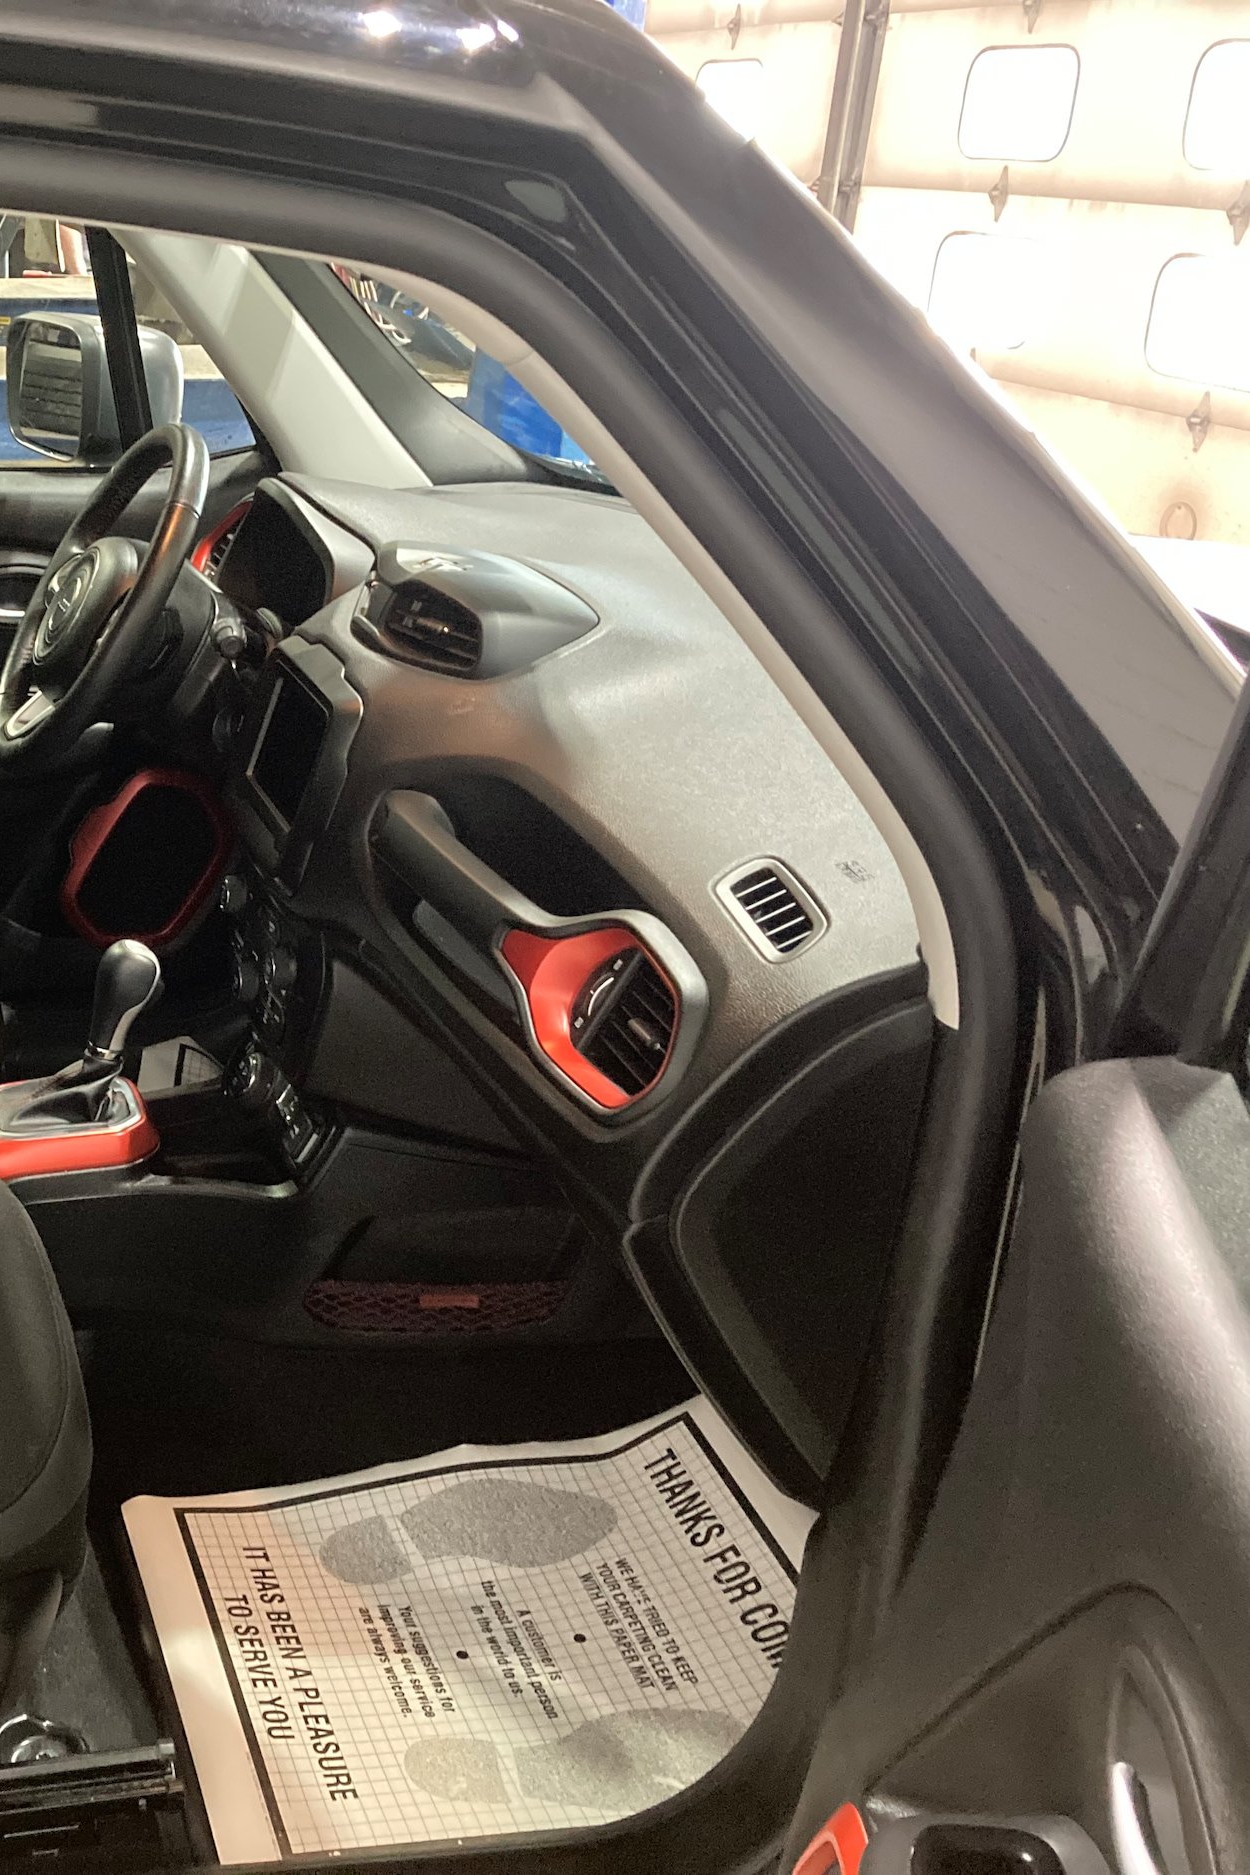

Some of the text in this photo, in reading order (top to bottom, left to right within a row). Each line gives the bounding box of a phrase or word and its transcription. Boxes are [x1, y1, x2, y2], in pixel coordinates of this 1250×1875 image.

[644, 1448, 726, 1547] THANKS
[703, 1544, 762, 1604] FOR
[358, 1607, 412, 1718] are always welcome.
[399, 1606, 455, 1712] Your suggestions for
[470, 1605, 485, 1615] in
[477, 1616, 493, 1634] the
[481, 1580, 558, 1720] the most important person
[486, 1635, 512, 1666] world
[516, 1609, 562, 1682] A customer is
[580, 1572, 655, 1689] WITH THIS PAPER MAT
[596, 1562, 678, 1691] YOUR CARPETING CLEAN
[615, 1558, 634, 1576] WE
[643, 1605, 670, 1638] TRIED
[662, 1638, 680, 1655] TO
[671, 1656, 699, 1684] KEEP
[223, 1594, 295, 1740] TO SERVE YOU
[242, 1546, 359, 1802] IT HAS BEEN A PLEASURE
[401, 1657, 417, 1675] our
[410, 1678, 435, 1718] service
[502, 1667, 515, 1680] to
